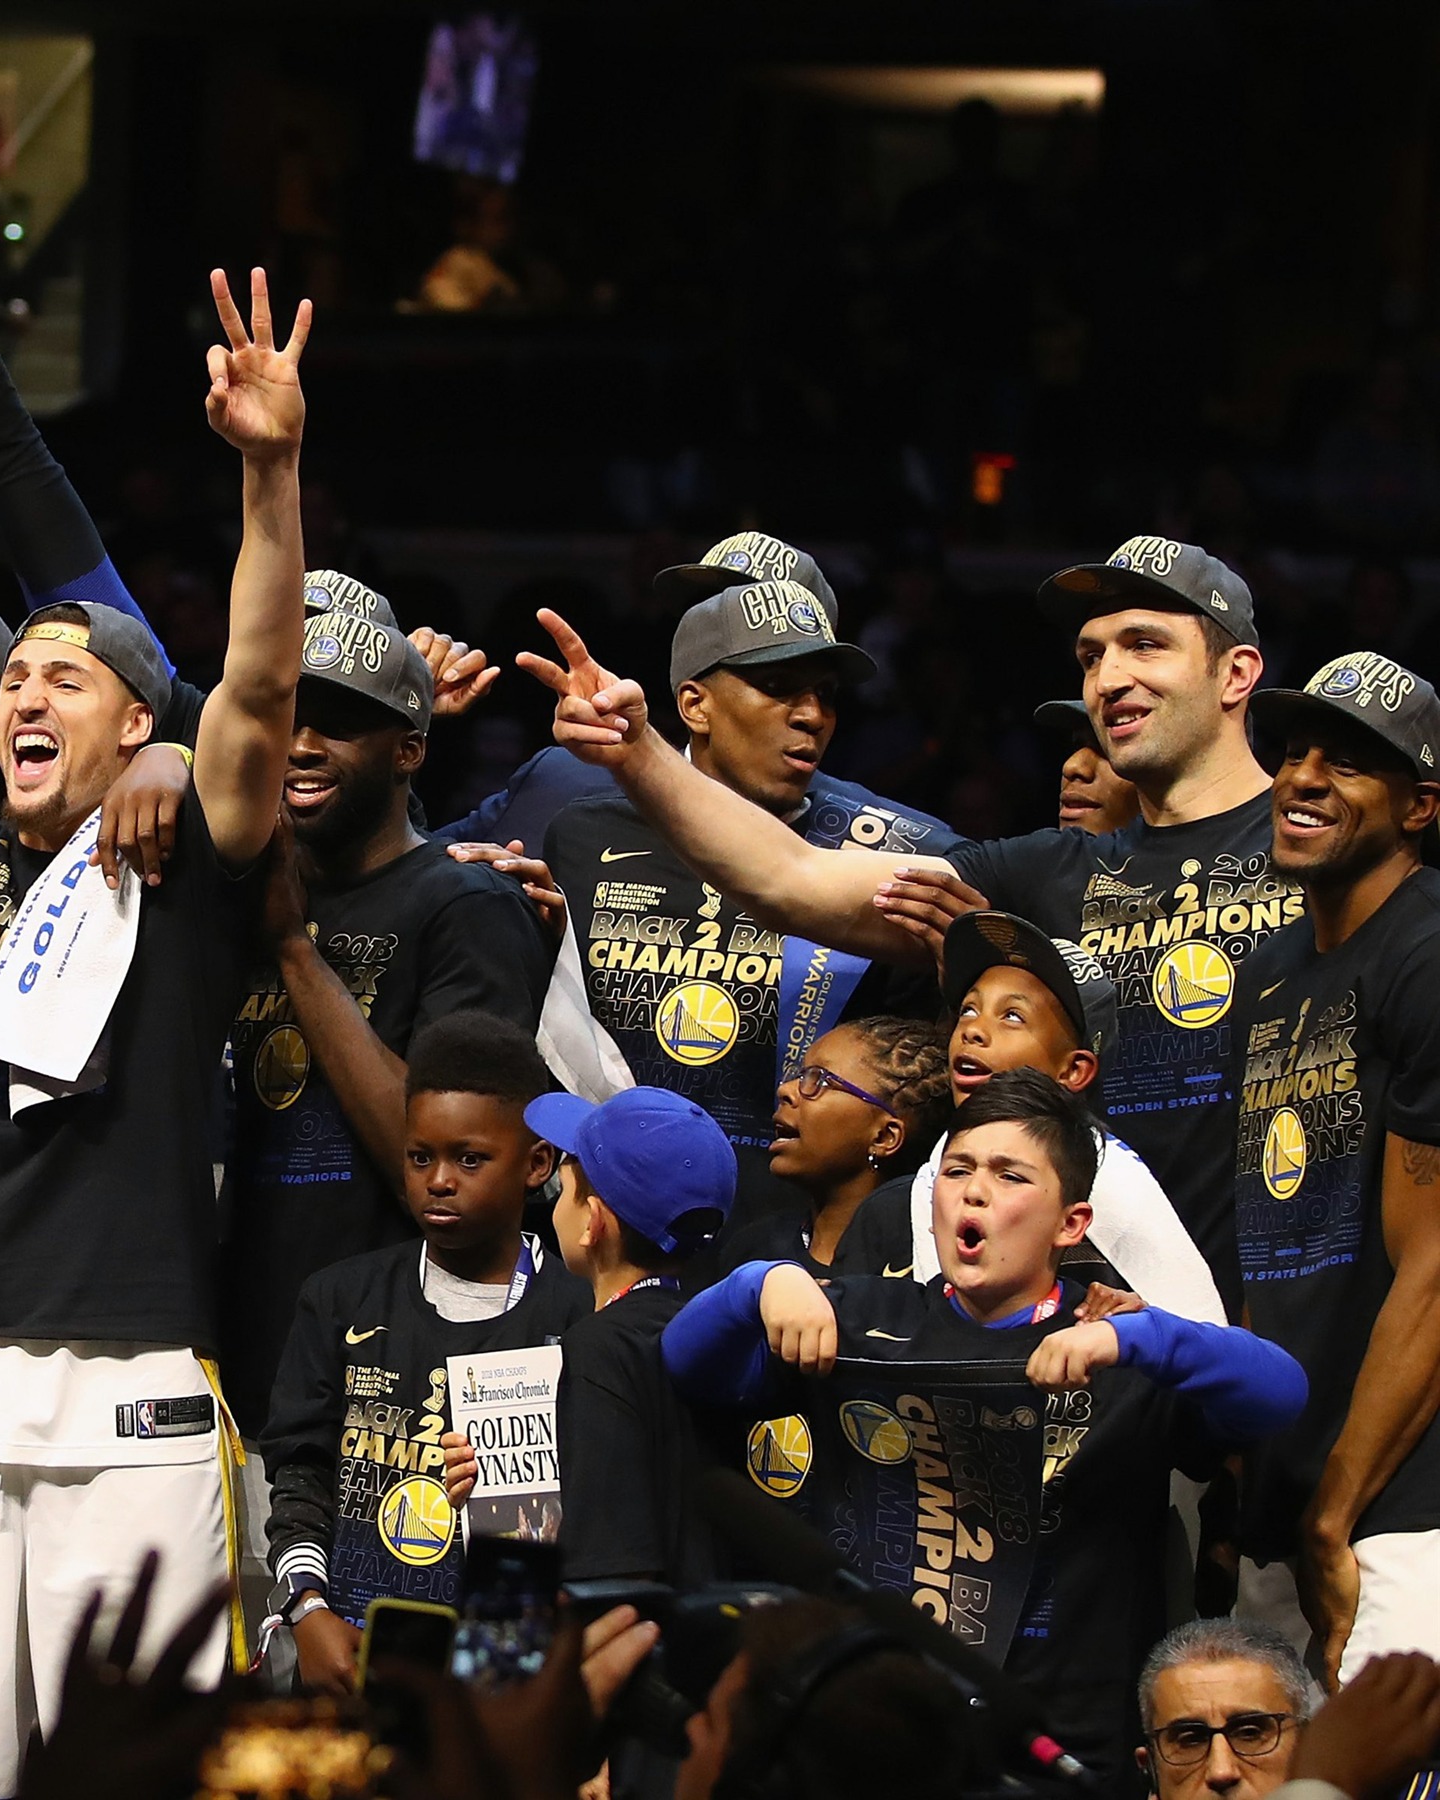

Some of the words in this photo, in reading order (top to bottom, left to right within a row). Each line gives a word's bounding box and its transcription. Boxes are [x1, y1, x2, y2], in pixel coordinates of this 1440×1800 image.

[771, 617, 788, 635] 20
[340, 657, 355, 675] 18
[607, 895, 660, 906] ASSOCIATION
[609, 888, 656, 898] BASKETBALL
[626, 883, 667, 894] NATIONAL
[1080, 889, 1167, 932] BACK
[1173, 882, 1202, 914] 2
[588, 911, 689, 947] BACK
[689, 921, 722, 950] 2
[1078, 895, 1306, 957] CHAMPIONS
[327, 933, 399, 964] 2018
[588, 939, 782, 986] CHAMPION
[782, 947, 832, 1074] WARRIORS
[812, 971, 834, 1024] GOLDEN
[1107, 1101, 1164, 1116] GOLDEN
[1167, 1093, 1219, 1109] STATE
[1240, 1060, 1358, 1116] HAMPIONS
[1256, 1268, 1297, 1281] STATE
[478, 1383, 514, 1402] Francisco
[515, 1379, 550, 1400] Chronicle
[344, 1399, 415, 1439] BACK
[411, 1414, 445, 1444] 2
[467, 1413, 552, 1450] GOLDEN
[340, 1427, 447, 1477] CHAMP
[476, 1450, 560, 1487] YNASTY
[955, 1518, 995, 1563] 2
